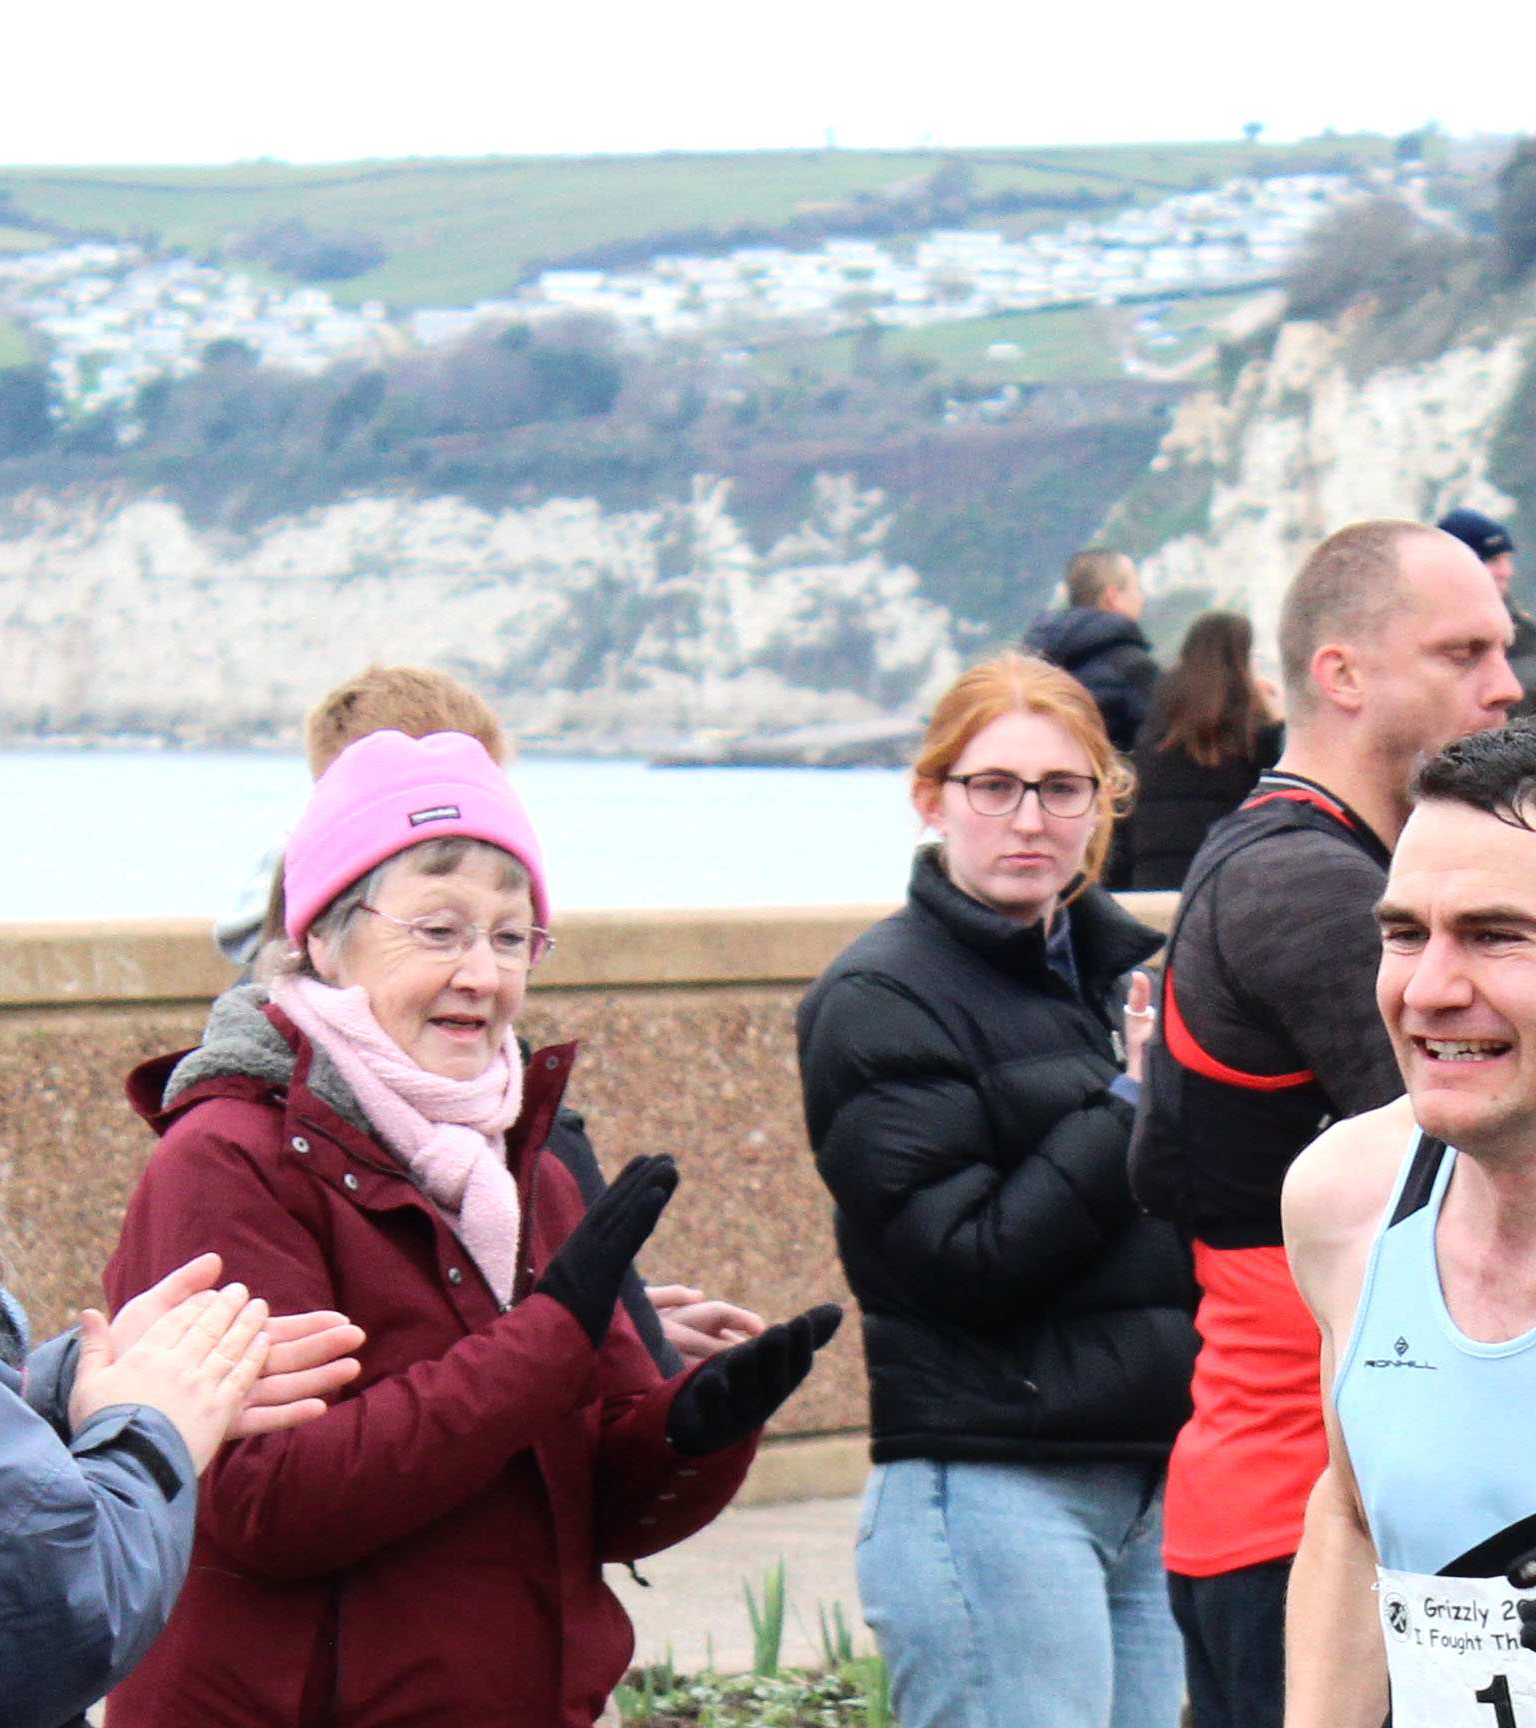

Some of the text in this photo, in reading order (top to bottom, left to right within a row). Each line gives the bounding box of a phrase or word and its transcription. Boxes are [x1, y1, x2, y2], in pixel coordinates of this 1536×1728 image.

[1424, 1597, 1489, 1629] Grizzly
[1414, 1628, 1519, 1655] I Fought Th
